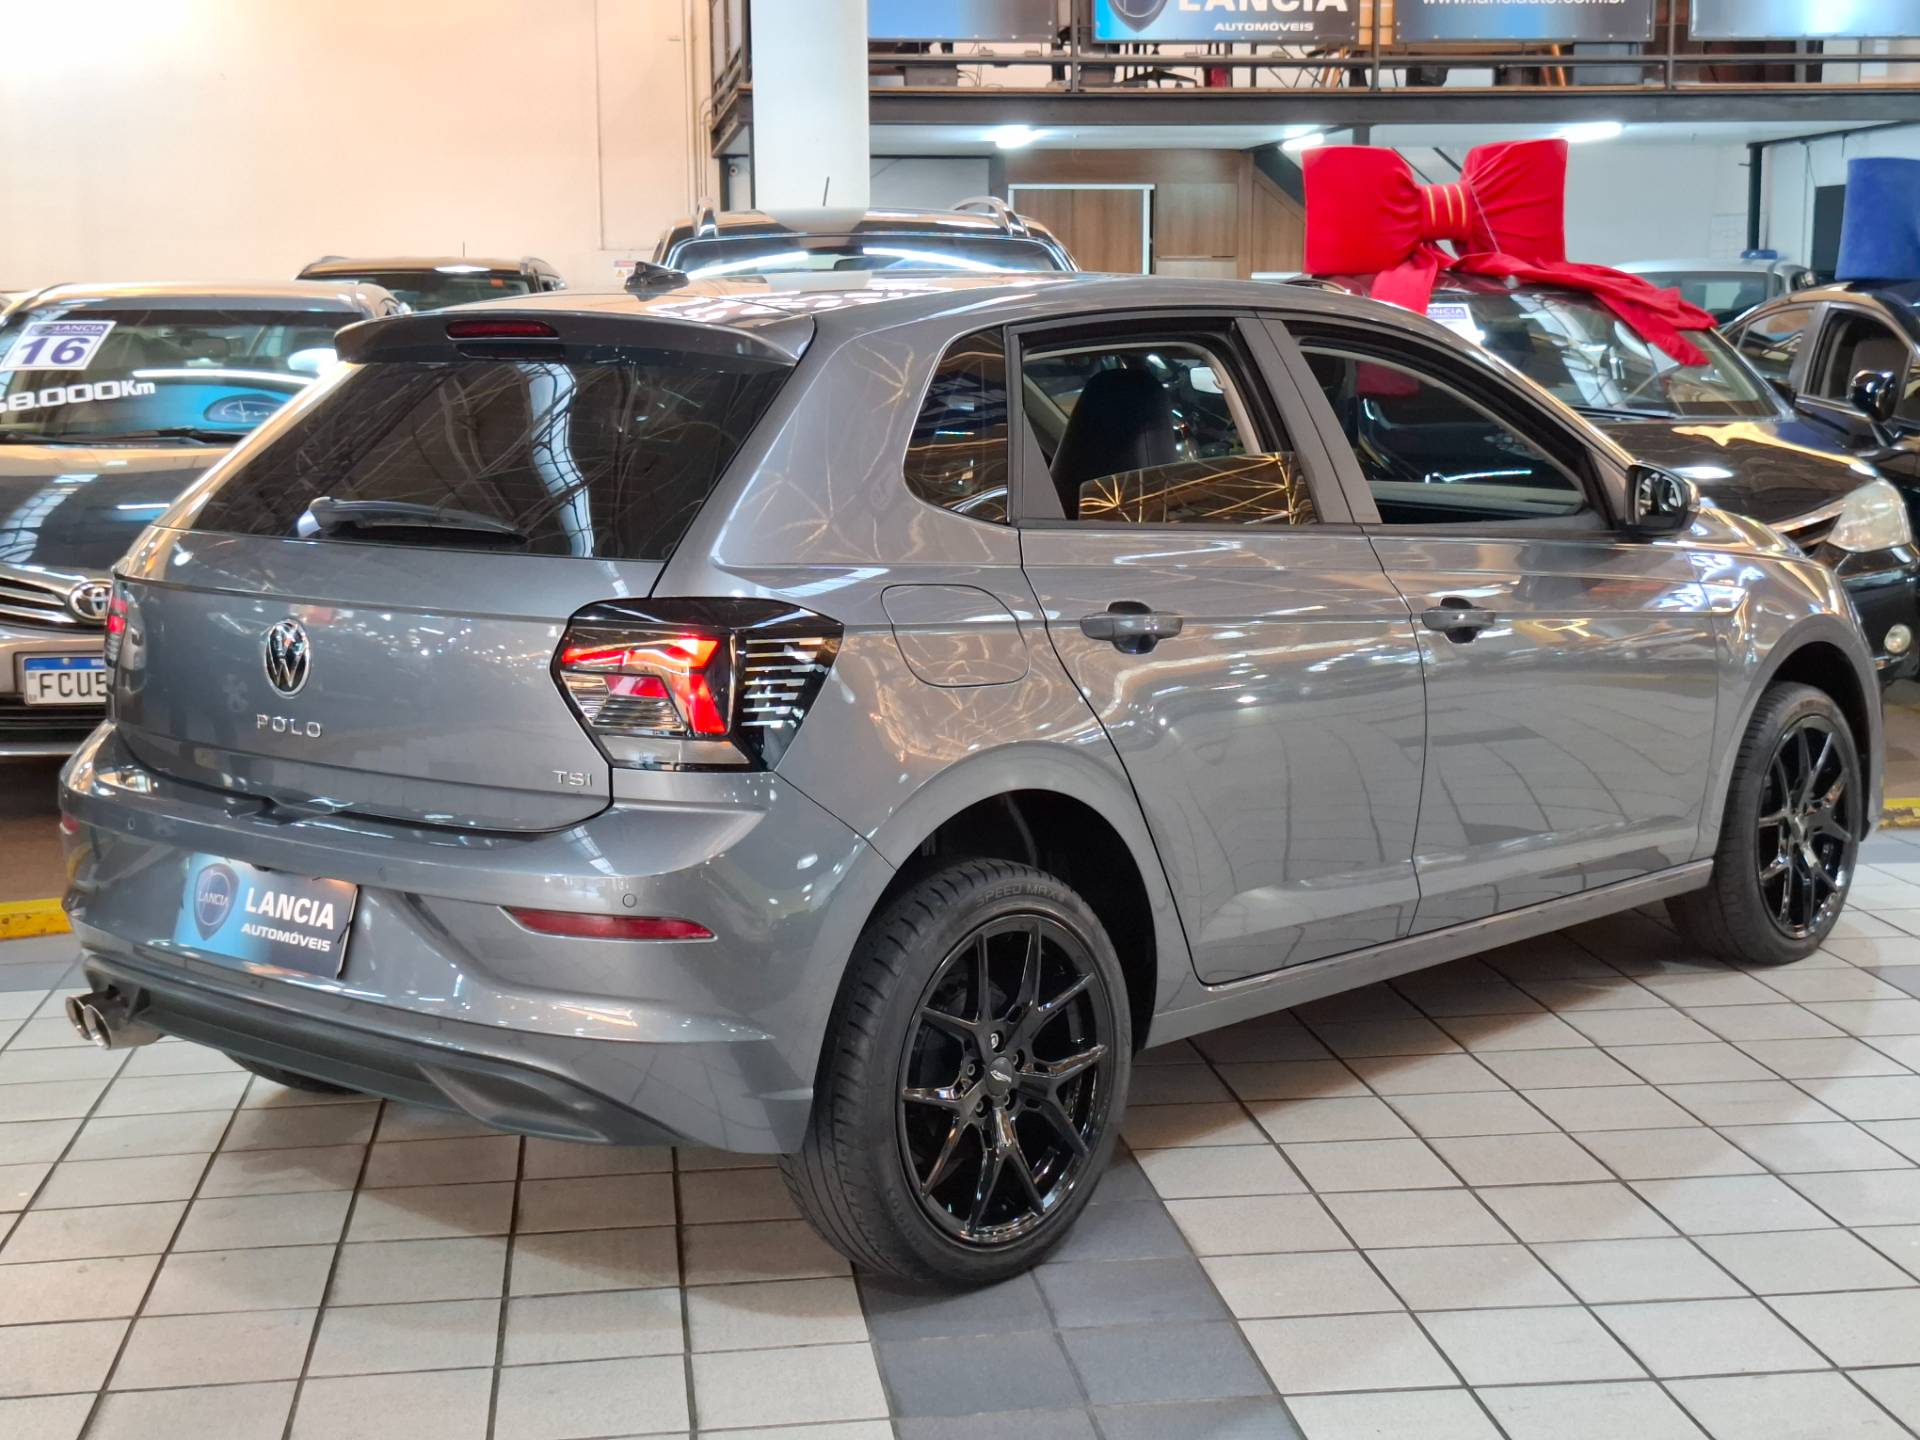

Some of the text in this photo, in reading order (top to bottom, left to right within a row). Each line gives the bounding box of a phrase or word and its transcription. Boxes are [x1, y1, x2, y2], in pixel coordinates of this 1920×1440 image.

[55, 324, 104, 332] LANCIA
[20, 337, 91, 365] 16
[0, 380, 155, 414] 8.000Km
[256, 714, 322, 738] POLO
[551, 770, 592, 786] TSI
[198, 890, 229, 906] LANCIA
[245, 887, 334, 930] LANCIA
[240, 922, 332, 952] AUTOMÓVEIS
